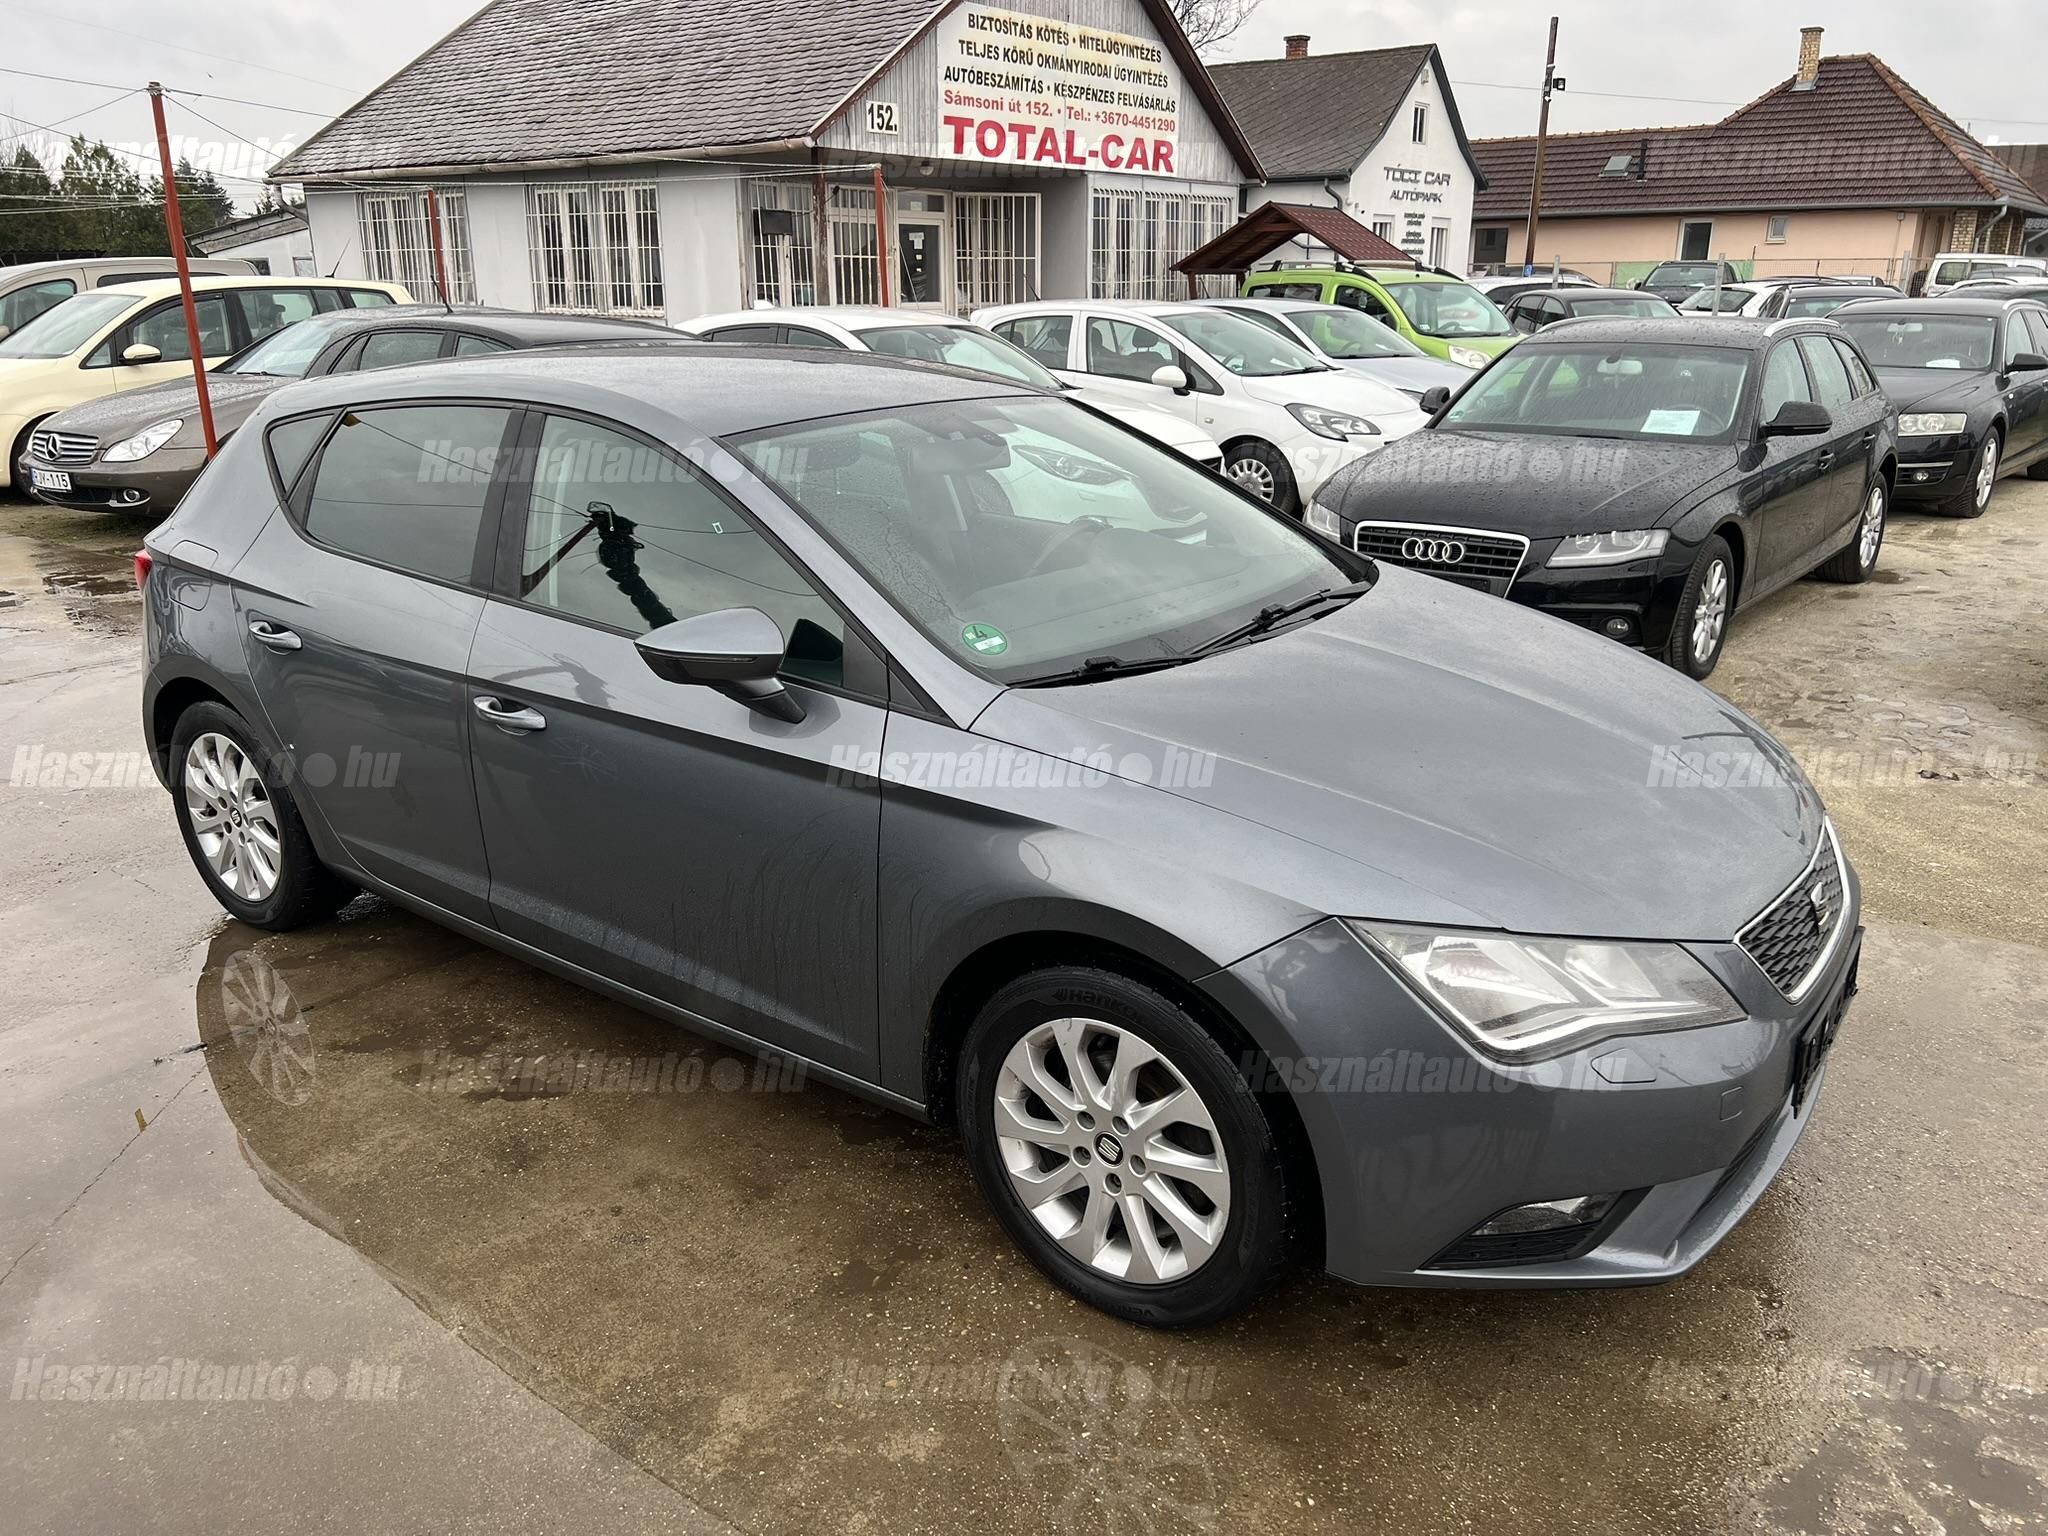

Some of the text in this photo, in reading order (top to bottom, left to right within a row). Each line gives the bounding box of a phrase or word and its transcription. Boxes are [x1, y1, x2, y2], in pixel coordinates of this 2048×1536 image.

[968, 13, 1162, 63] BIZTOSÍTÁS KÖTÉS HITELÜGYINTÉZÉS
[959, 39, 1000, 59] TELJES
[1037, 55, 1111, 79] OKMÁNYIRODAI
[1114, 67, 1168, 88] ÜGYINTÉZÉS
[944, 66, 1176, 113] AUTÓBESZÁMÍTÁS KÉSZPÉNZES FELVÁSÁRLÁS
[944, 90, 1176, 132] Sámsoni út 152. Tel.: +3670-4451290
[868, 103, 897, 132] 152.
[943, 115, 1175, 173] TOTAL-CAR
[1389, 188, 1443, 203] AUTÓPARK
[1424, 171, 1451, 186] CAR
